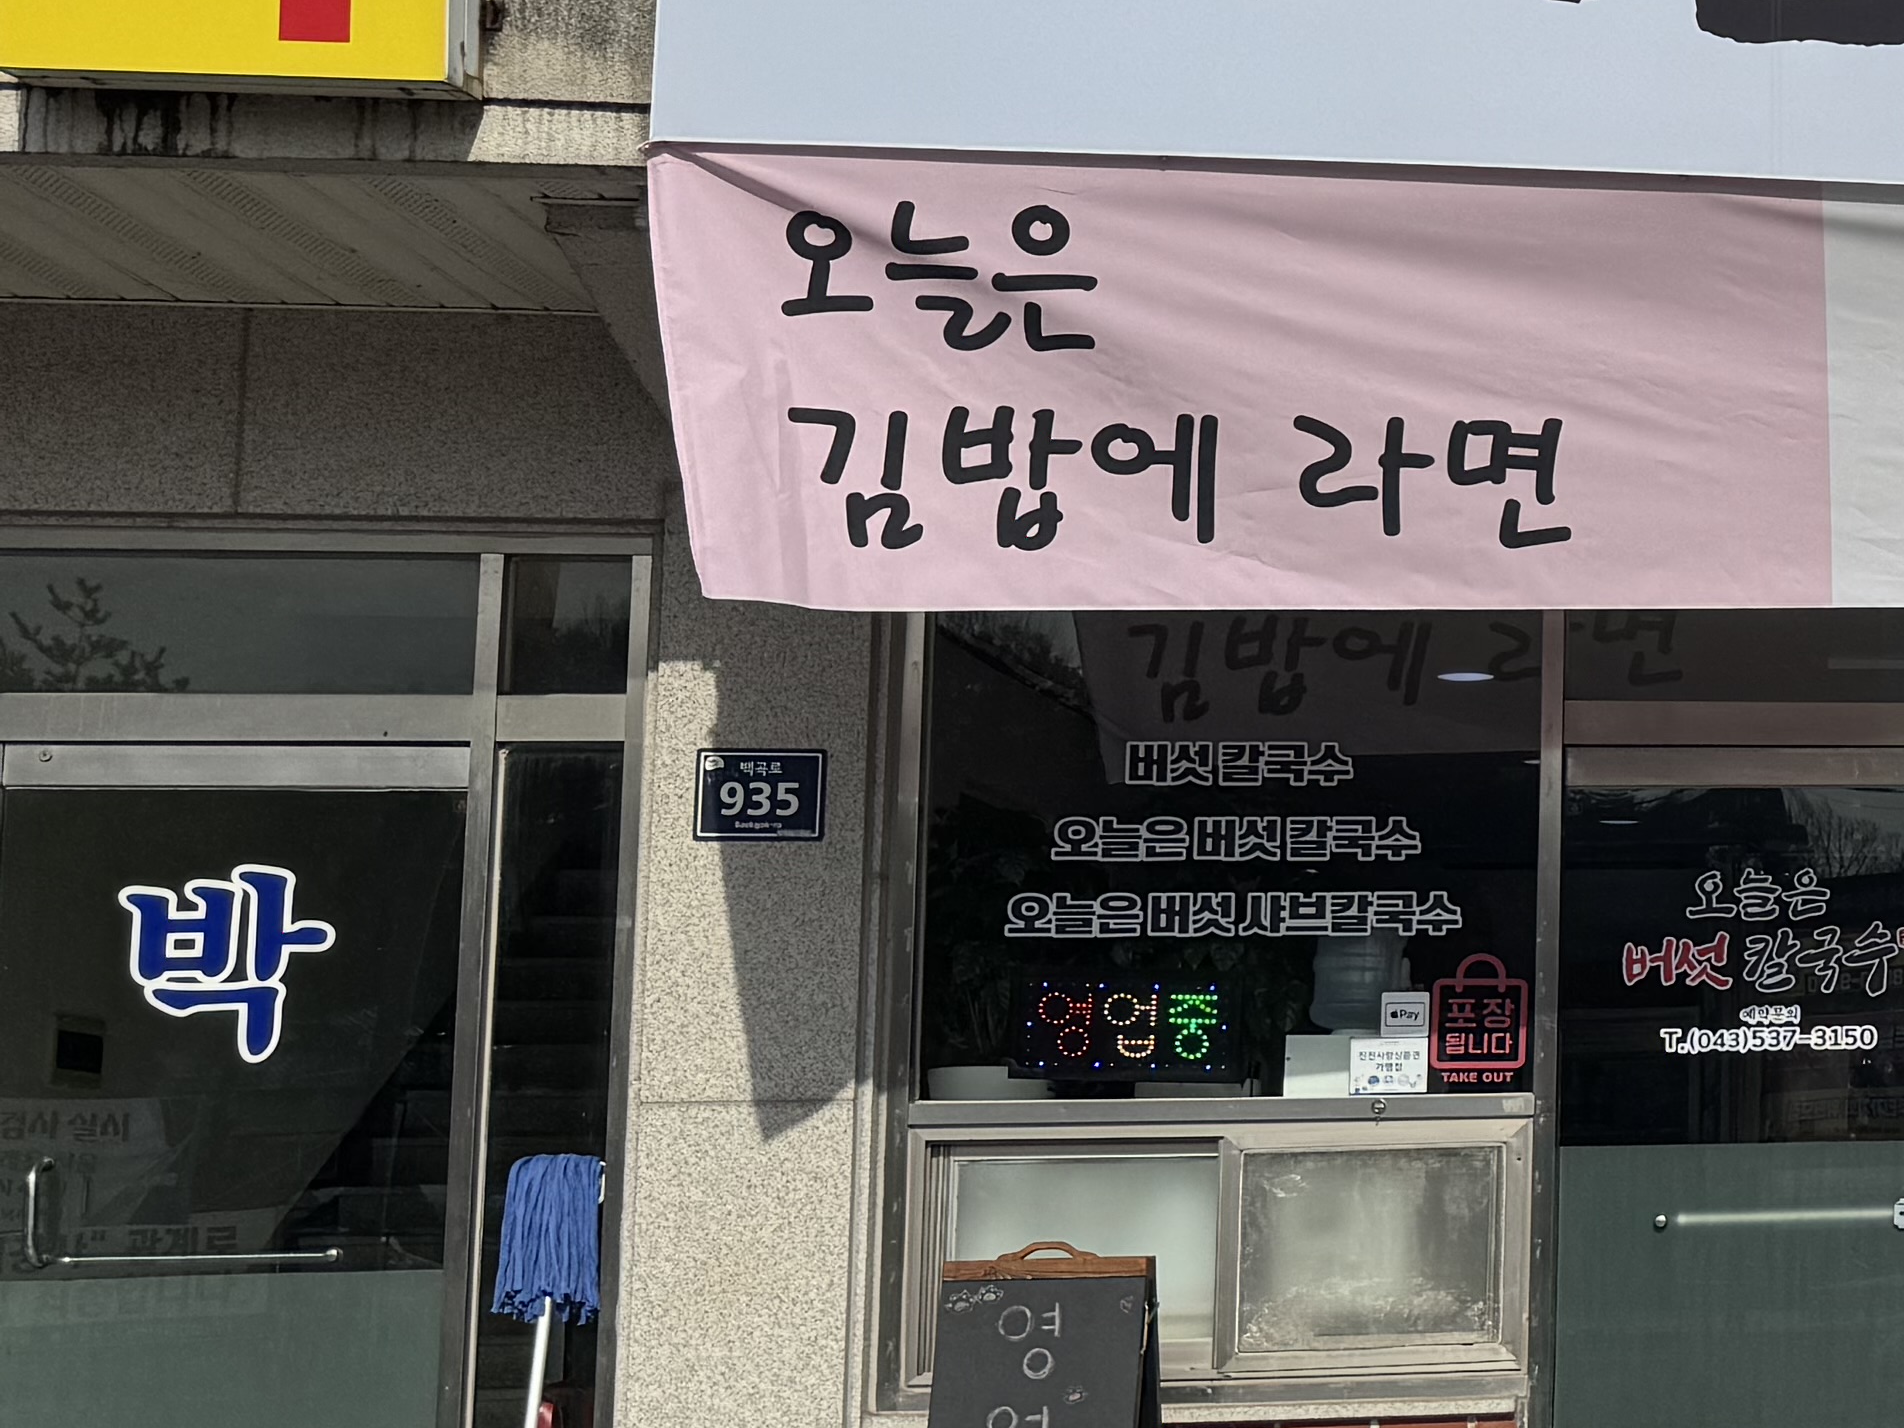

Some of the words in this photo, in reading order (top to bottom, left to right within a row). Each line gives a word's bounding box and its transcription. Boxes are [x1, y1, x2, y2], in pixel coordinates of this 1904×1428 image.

[782, 200, 1098, 352] 오늘은
[787, 404, 1220, 552] 김밥에
[1294, 415, 1572, 550] 라면
[740, 761, 783, 777] 백곡로
[1125, 742, 1213, 786] 버섯
[1218, 742, 1353, 786] 칼국수
[720, 781, 799, 816] 935
[1051, 816, 1188, 862] 오늘은
[1193, 816, 1281, 862] 버섯
[1286, 816, 1421, 862] 칼국수
[1004, 892, 1143, 937] 오늘은
[1147, 892, 1235, 937] 버섯
[1239, 891, 1462, 937] 샤브칼국수
[1686, 868, 1831, 922] 오늘은
[118, 864, 336, 1064] 박
[1622, 931, 1733, 991] 버섯
[1743, 921, 1900, 997] 칼국수
[1038, 991, 1218, 1059] 영업중
[1400, 1009, 1420, 1021] Pay
[1445, 998, 1515, 1029] 포장
[1739, 1004, 1801, 1025] 예약문의
[1445, 1032, 1513, 1055] 됩니다
[1660, 1025, 1878, 1054] T.(043)537-3150
[1441, 1072, 1478, 1083] TAKE
[1482, 1072, 1514, 1083] OUT
